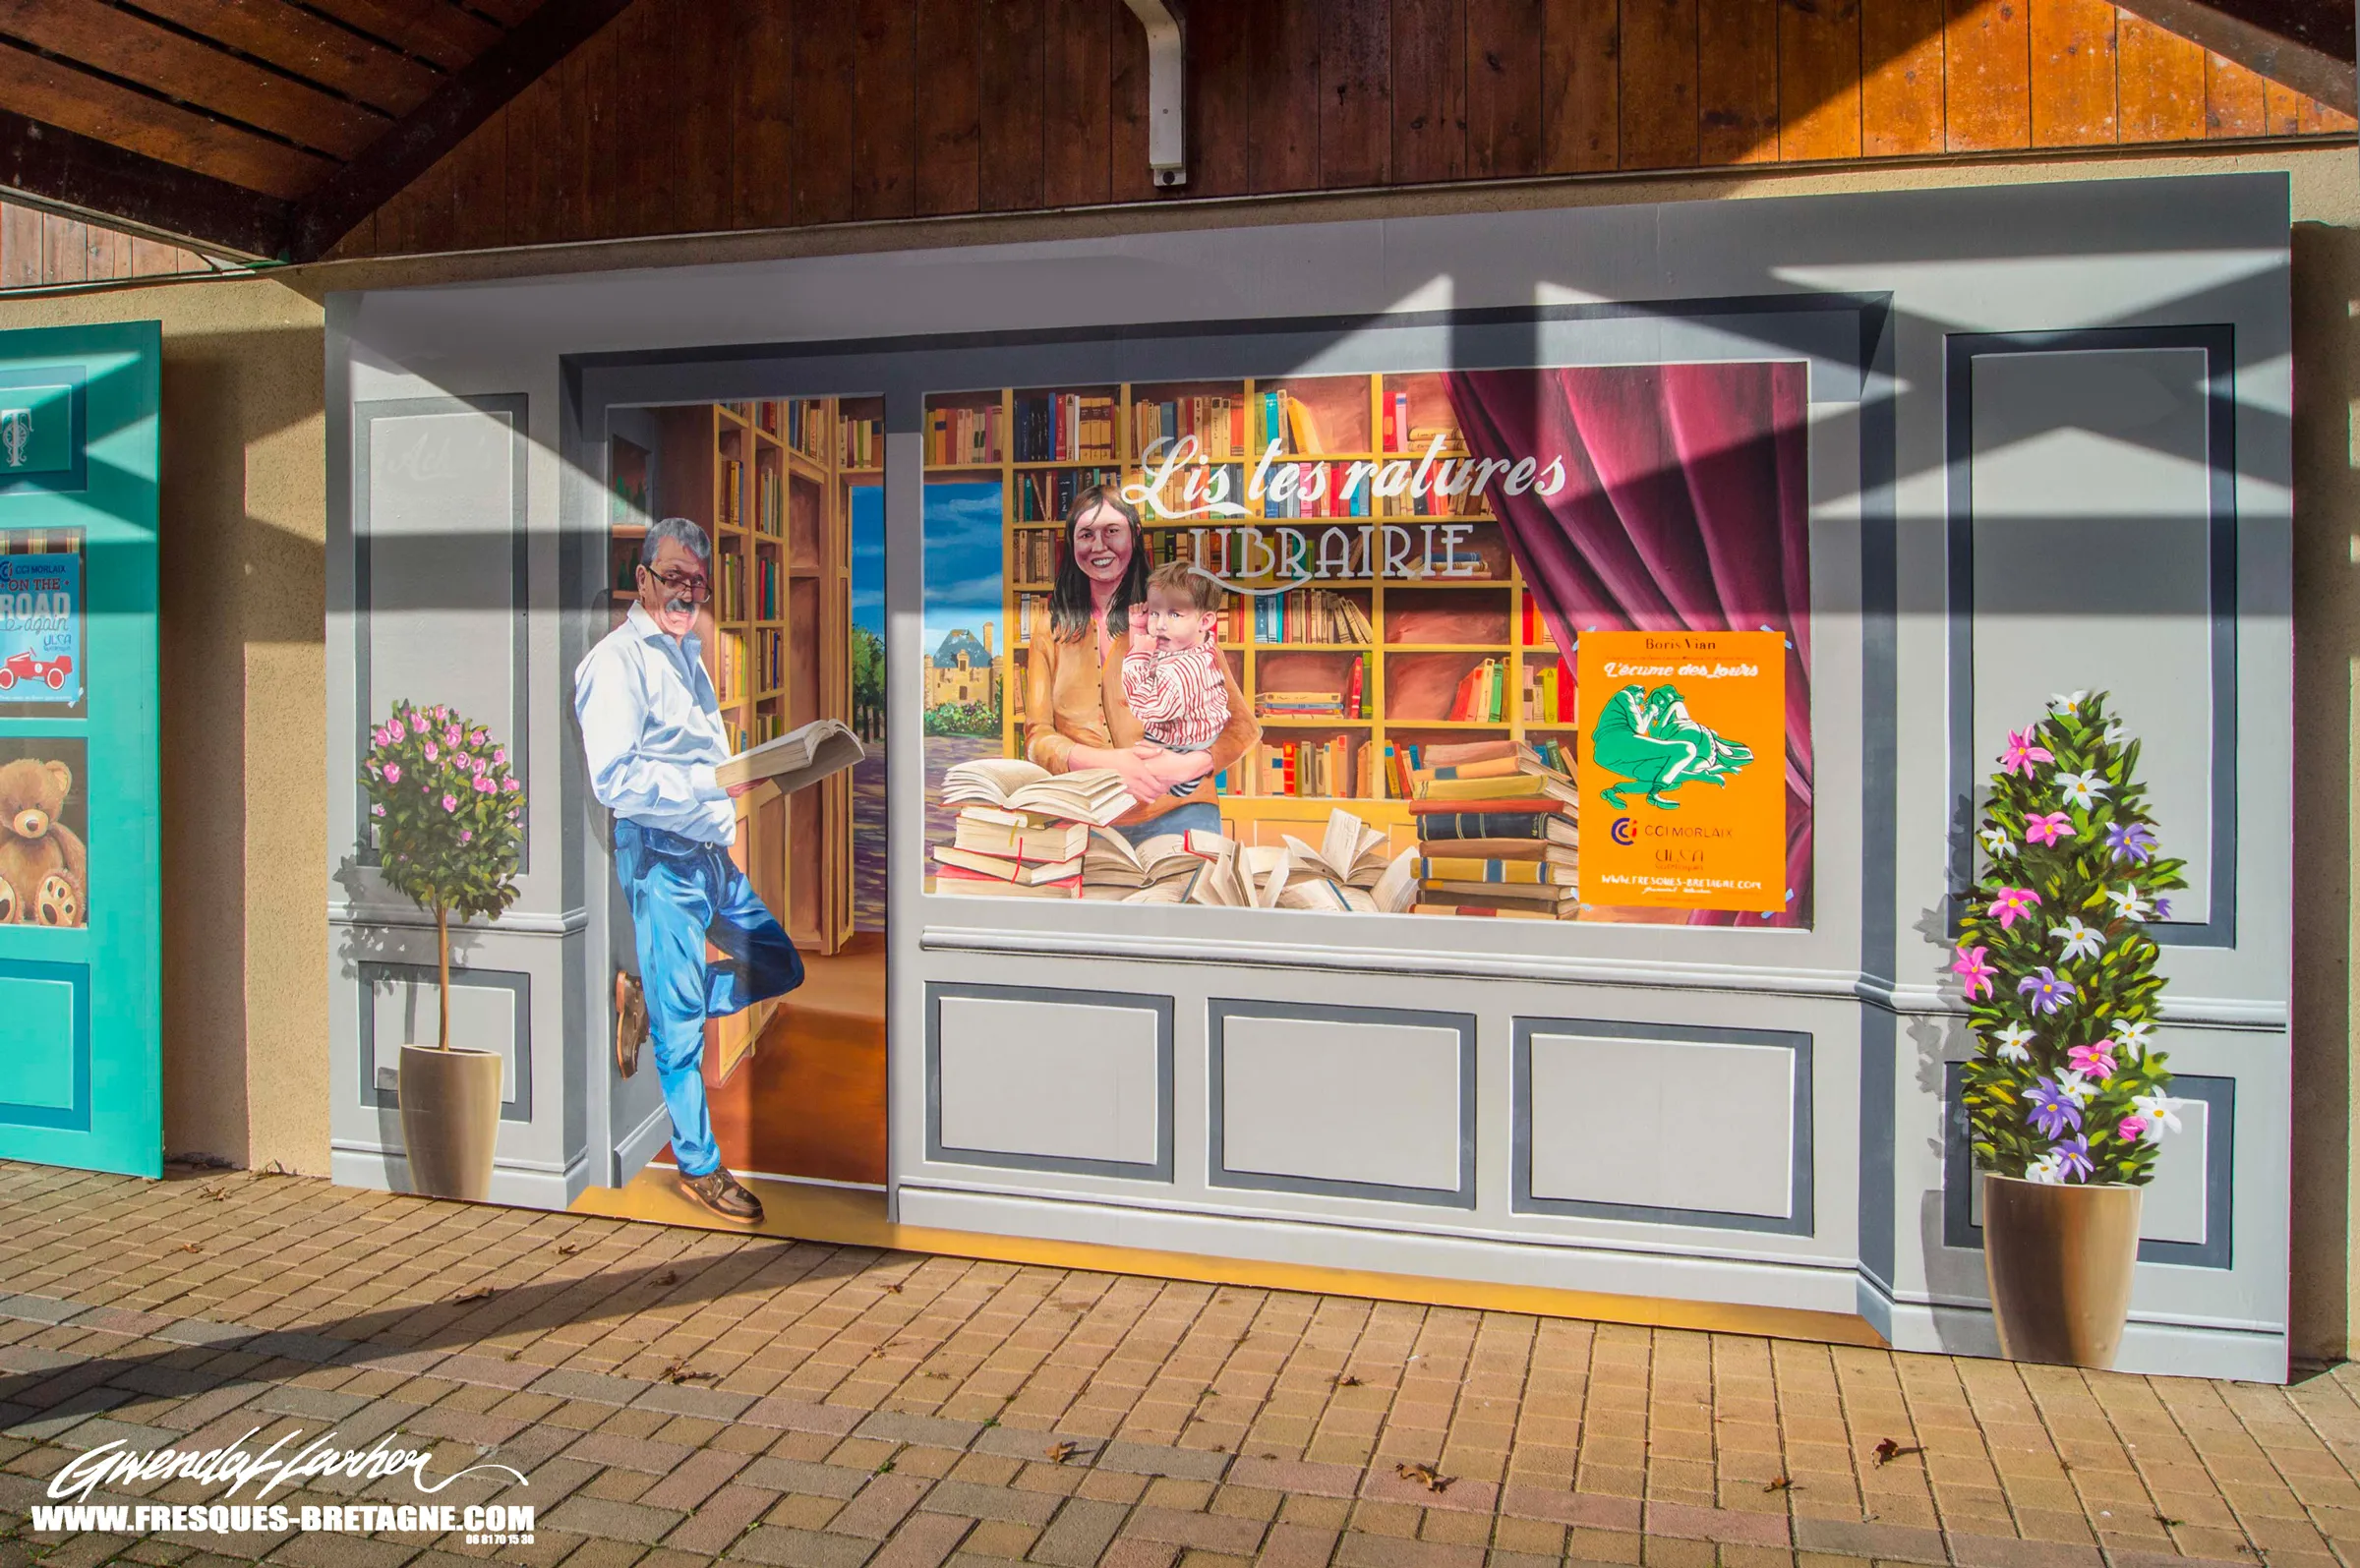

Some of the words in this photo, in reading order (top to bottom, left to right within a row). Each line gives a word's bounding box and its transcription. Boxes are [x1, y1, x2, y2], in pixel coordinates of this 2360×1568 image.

[1121, 434, 1253, 520] Lis
[1248, 437, 1327, 502] tes
[1338, 434, 1565, 501] ratures
[1187, 523, 1474, 596] LIBRAIRIE
[15, 564, 30, 574] CCI
[31, 564, 66, 574] MORLAIX
[8, 579, 30, 592] ON
[33, 578, 61, 591] THE
[0, 592, 71, 621] ROAD
[1645, 637, 1681, 650] Boris
[1684, 637, 1716, 650] Vian
[1678, 663, 1708, 676] des
[1644, 825, 1669, 837] CCI
[1672, 827, 1733, 839] MORLAIX
